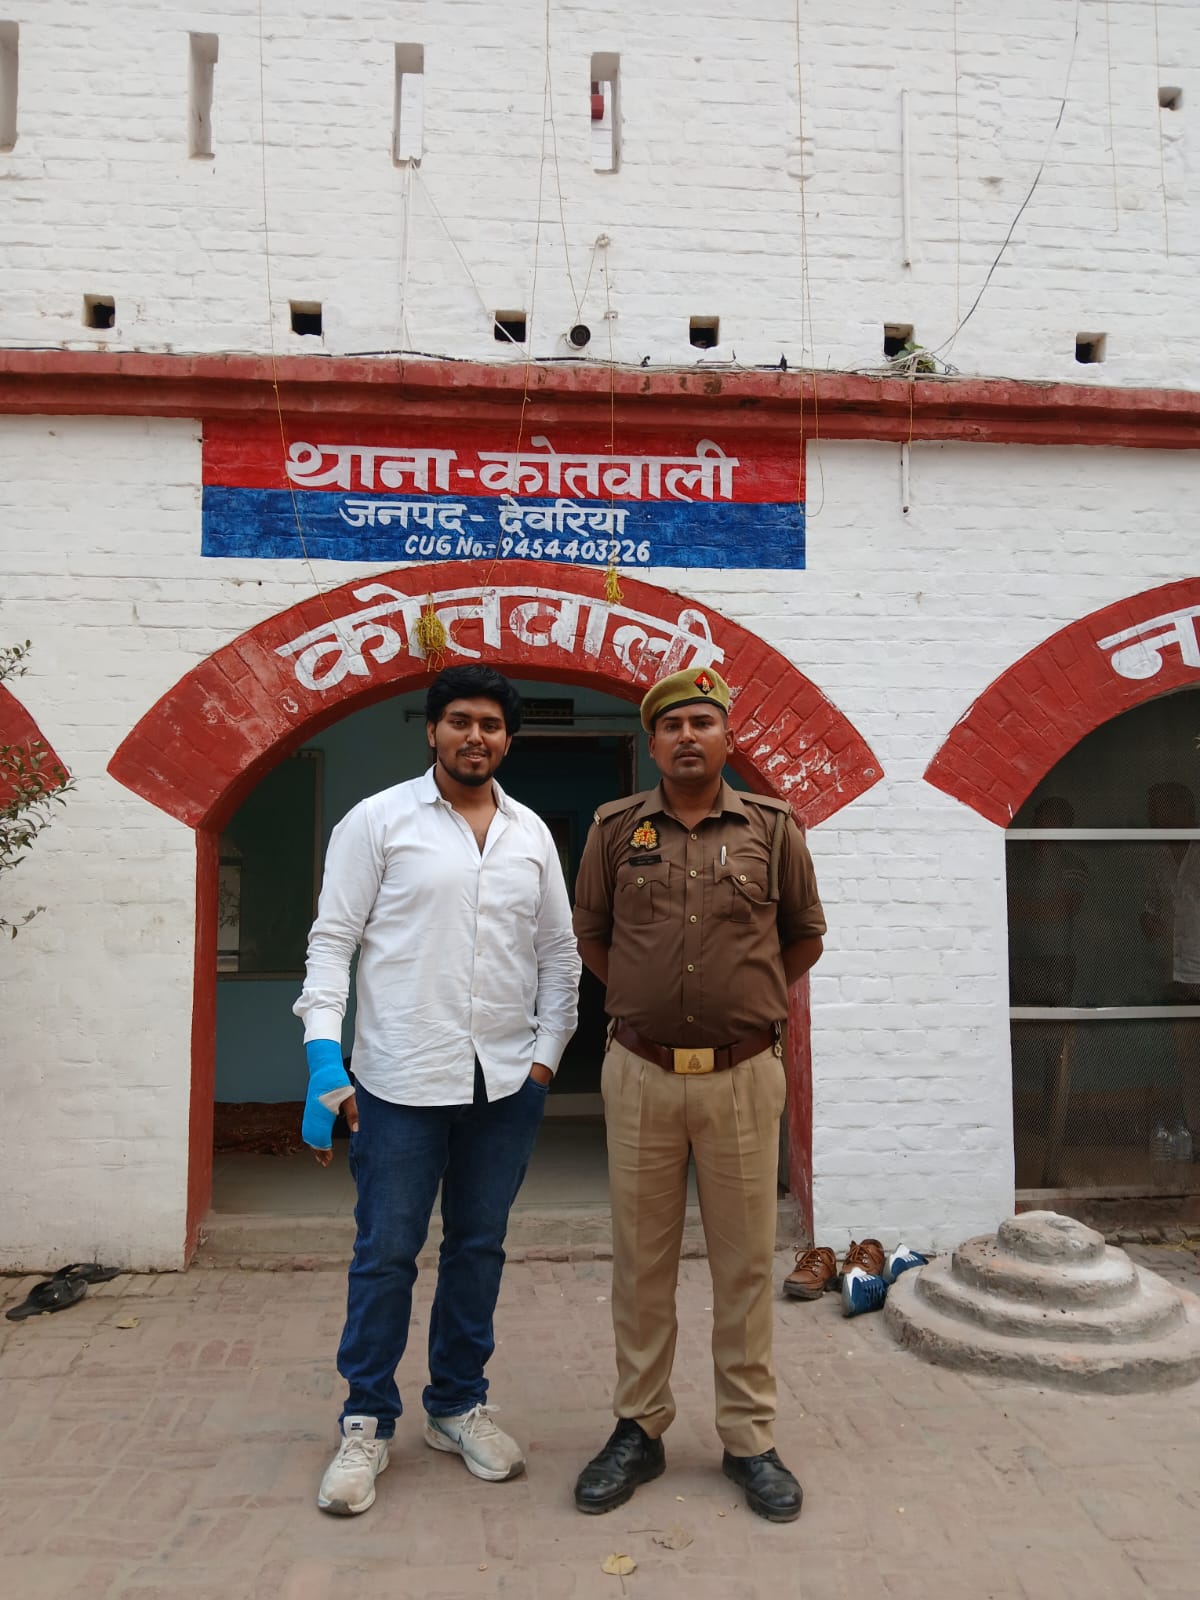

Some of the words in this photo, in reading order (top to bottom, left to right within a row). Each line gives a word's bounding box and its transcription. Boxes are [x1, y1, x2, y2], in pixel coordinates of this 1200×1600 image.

[498, 494, 630, 537] देवरिया
[405, 535, 451, 555] CUG
[502, 537, 650, 562] 9454403226
[274, 583, 725, 691] कोतवाली
